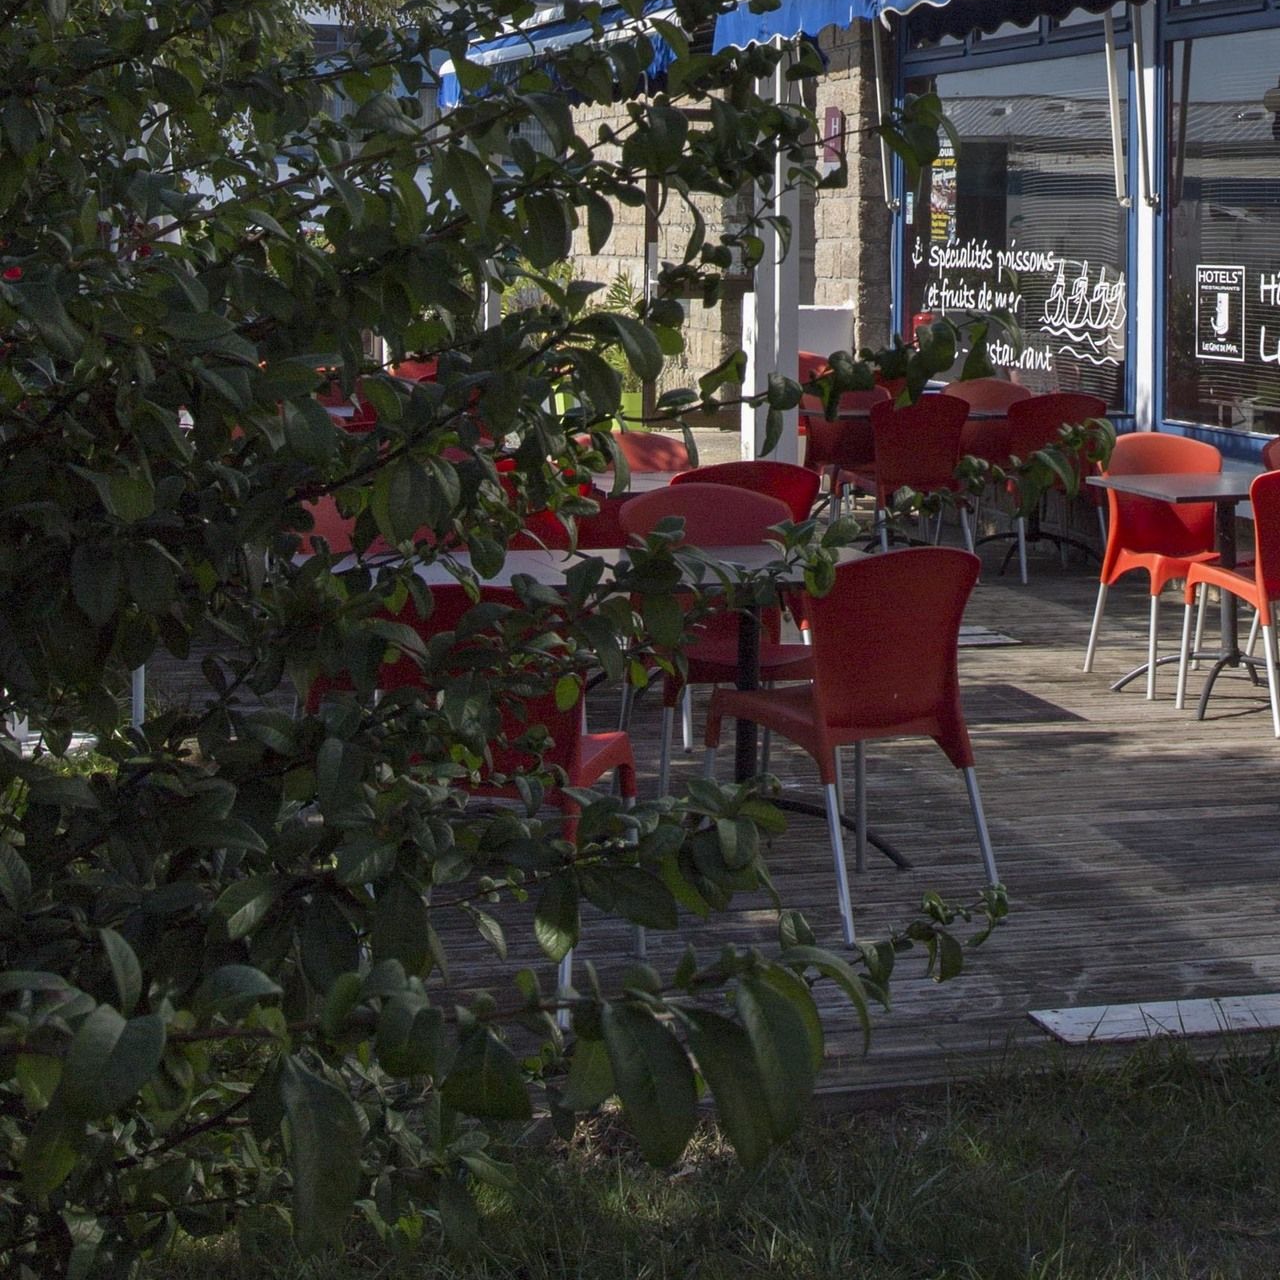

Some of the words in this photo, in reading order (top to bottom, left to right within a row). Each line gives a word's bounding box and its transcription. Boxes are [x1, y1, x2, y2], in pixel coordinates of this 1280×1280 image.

[928, 237, 993, 279] Spécialités
[1198, 270, 1238, 283] HOTELS
[928, 282, 939, 307] et
[940, 278, 976, 317] fruits
[977, 281, 993, 310] de
